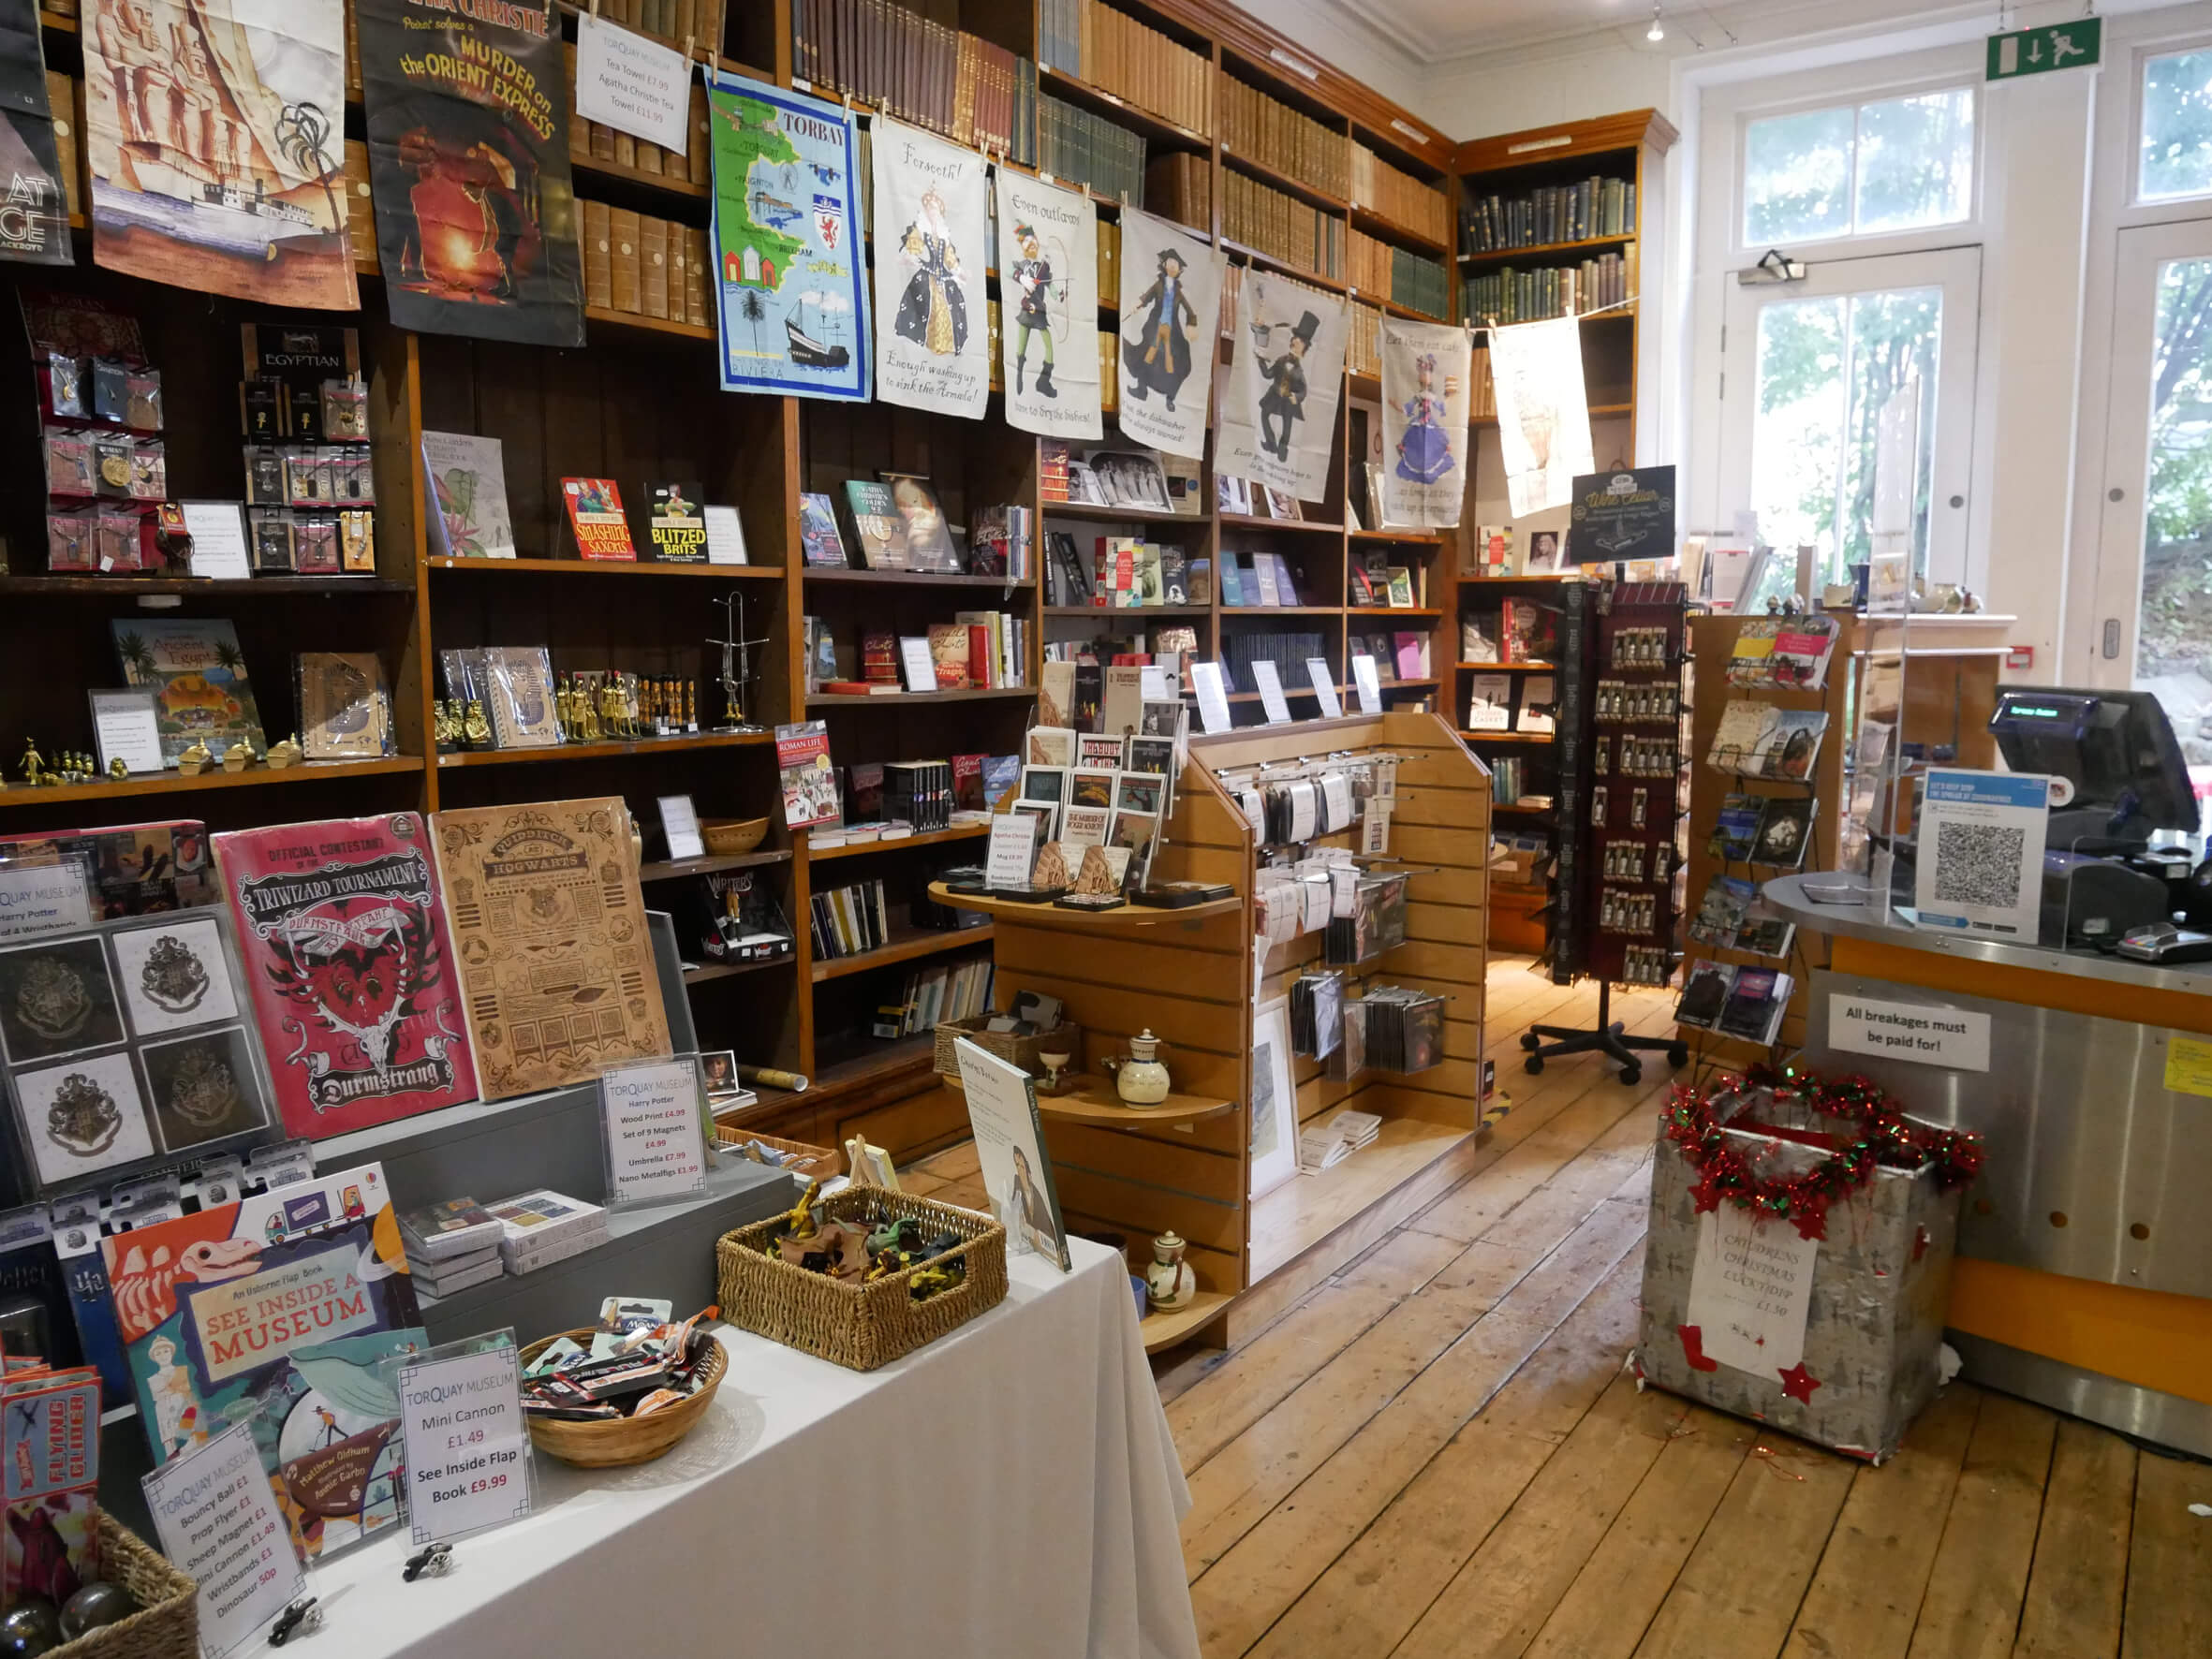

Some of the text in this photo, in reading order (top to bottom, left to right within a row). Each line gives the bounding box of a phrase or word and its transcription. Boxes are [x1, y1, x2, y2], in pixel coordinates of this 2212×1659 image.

[459, 0, 549, 39] CHRISTIE
[461, 35, 553, 113] MURDER on
[599, 74, 628, 92] Agatha
[607, 58, 620, 71] Tea
[623, 65, 645, 81] Towel
[400, 53, 554, 140] the ORIENT EXPRESS
[610, 95, 635, 111] Towel
[783, 113, 844, 146] TORBAY
[7, 172, 48, 207] AT
[265, 354, 340, 367] EGYPTIAN
[886, 350, 928, 375] Enough
[576, 524, 630, 541] SMASHING
[652, 528, 705, 544] BLITZED
[589, 541, 628, 554] SAXONS
[663, 544, 697, 555] BRITS
[779, 738, 821, 751] ROMAN LIFE
[268, 846, 317, 861] OFFICIAL
[494, 856, 578, 874] HOGWARTS
[36, 885, 82, 899] MUSEUM
[254, 861, 419, 913] TRIWIZARD TOURNAMENT
[28, 909, 58, 918] Potter
[1846, 1007, 1967, 1034] All breakages must
[1867, 1031, 1940, 1051] be paid for!
[322, 1063, 439, 1103] Durmstrang
[611, 1078, 691, 1096] TORQUAY MUSEUM
[620, 1108, 686, 1123] Wood Print £4.99
[628, 1096, 674, 1108] Harry Potter
[623, 1124, 686, 1139] Set of 9 Magnets
[645, 1139, 667, 1150] £4.99
[628, 1152, 686, 1167] Umbrella £7.99
[619, 1175, 640, 1184] Nano
[641, 1168, 676, 1181] Metalfigs
[233, 1264, 323, 1300] An Usborne Flap Book
[206, 1272, 360, 1336] SEE INSIDE A
[210, 1290, 367, 1364] MUSEUM
[406, 1373, 514, 1406] TORQUAY MUSEUM
[421, 1403, 506, 1431] Mini Cannon
[48, 1401, 66, 1483] FLYING
[69, 1395, 85, 1478] GLIDER
[448, 1430, 484, 1449] £1.49
[300, 1457, 335, 1487] Matthew
[418, 1450, 517, 1482] See Inside Flap
[160, 1446, 256, 1519] TORQUAY MUSEUM
[433, 1475, 508, 1504] Book £9.99
[181, 1475, 249, 1529] Bouncy Ball £1
[191, 1496, 252, 1545] Prop Flyer £1
[187, 1507, 267, 1571] Sheep Magnet £1
[214, 1521, 276, 1574] Cannon £1.49
[207, 1548, 273, 1601] Wristbands £1
[216, 1567, 277, 1619] Dinosaur 50p
